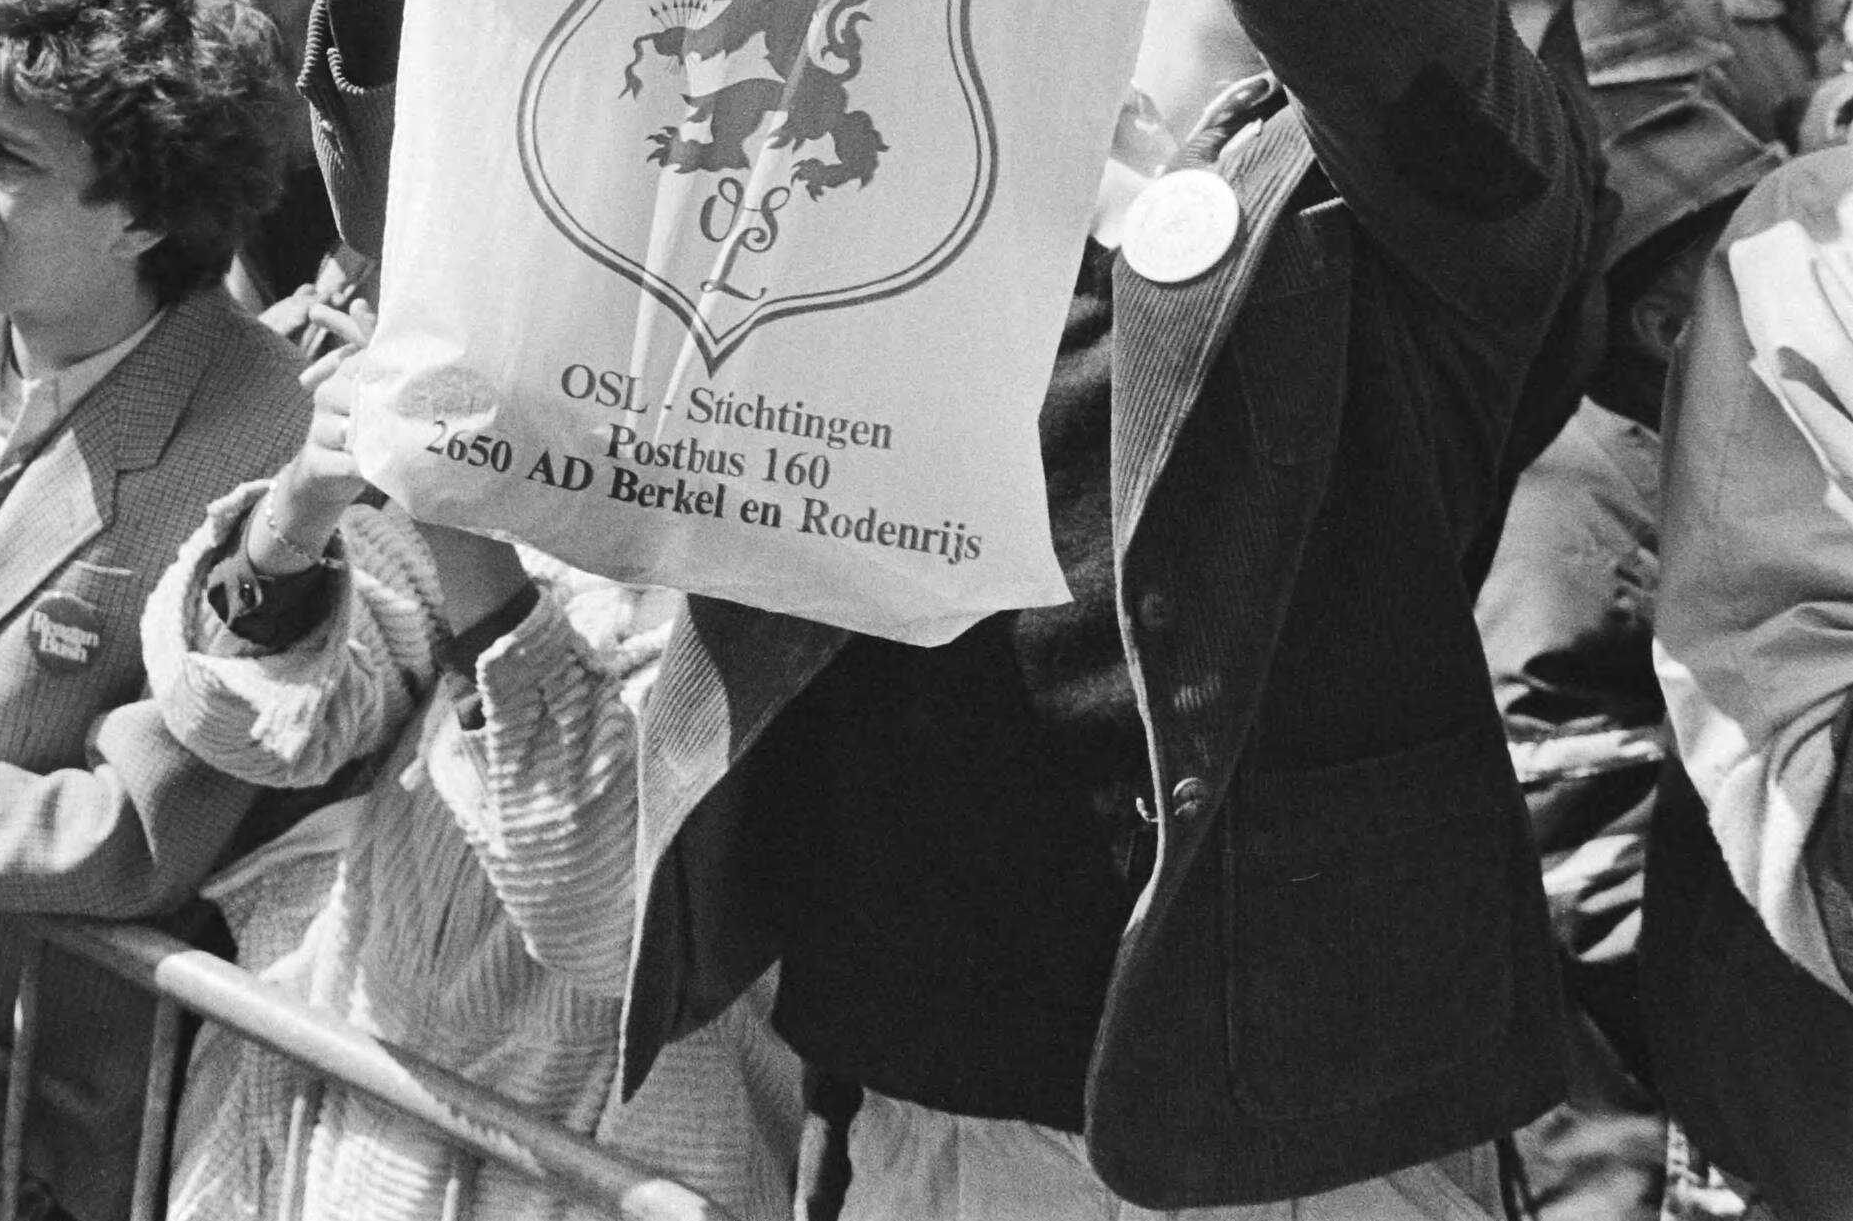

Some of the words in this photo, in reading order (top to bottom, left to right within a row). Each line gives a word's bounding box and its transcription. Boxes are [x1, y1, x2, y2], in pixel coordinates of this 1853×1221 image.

[560, 364, 649, 415] OSL
[686, 386, 894, 452] Stichtingen
[426, 420, 513, 473] 2650
[525, 450, 595, 492] AD
[607, 466, 725, 520] Berkel
[739, 501, 782, 530] en
[800, 497, 984, 566] Rodenrijs
[605, 423, 746, 478] Postbus
[761, 446, 831, 490] 160
